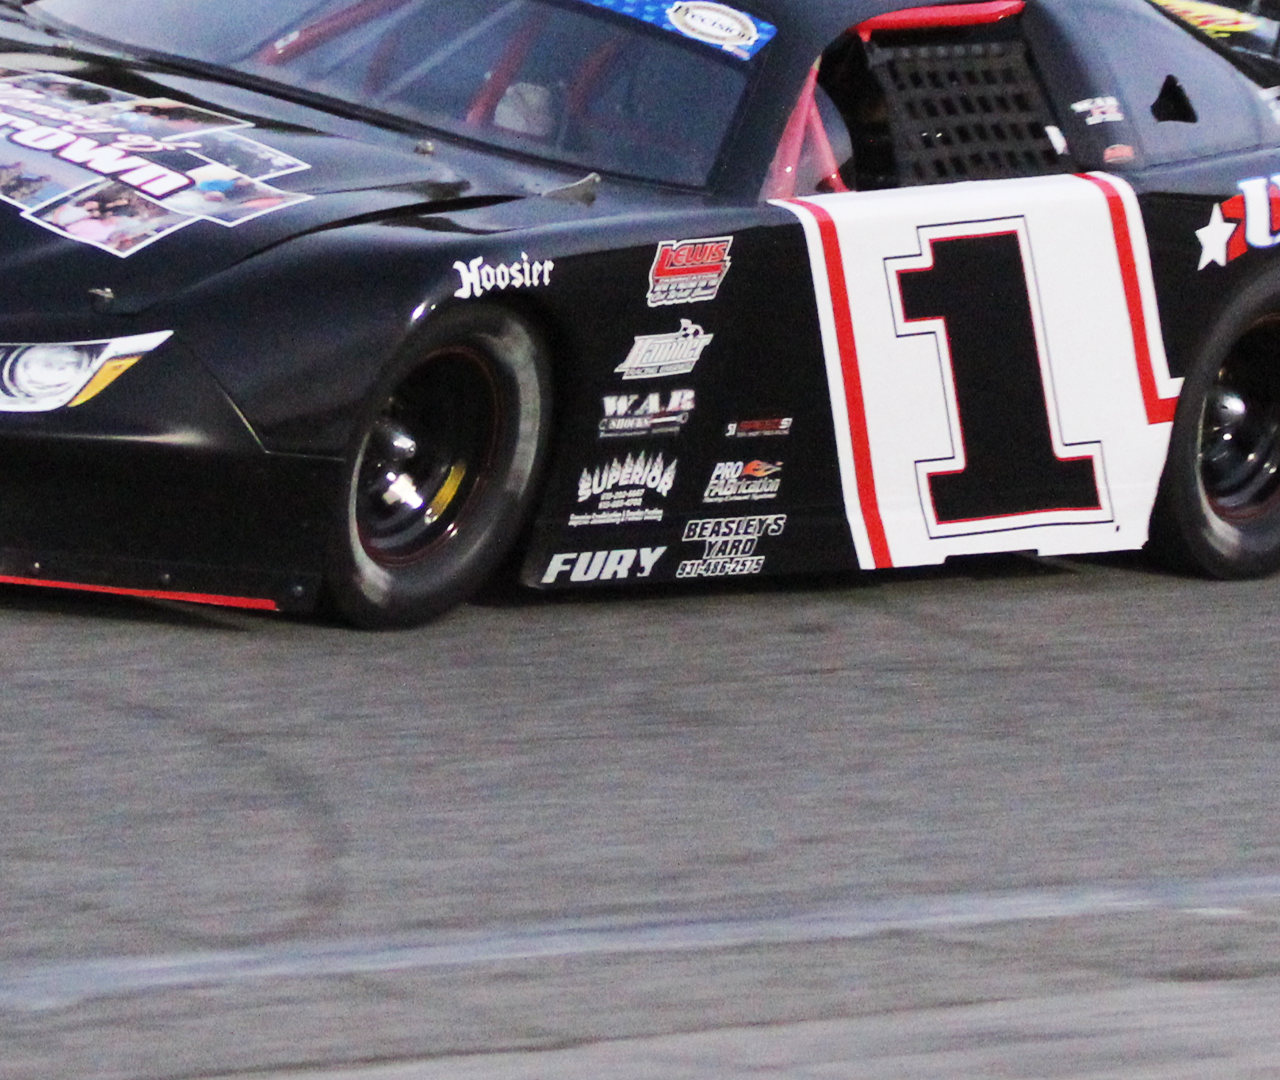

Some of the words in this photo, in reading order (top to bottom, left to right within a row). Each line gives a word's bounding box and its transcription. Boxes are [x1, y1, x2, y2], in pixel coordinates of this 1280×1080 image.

[452, 252, 555, 299] Hoosier
[894, 228, 1104, 528] 1
[577, 450, 678, 503] SUPERIOR
[711, 461, 744, 482] PRO
[682, 514, 788, 541] BEASLEY'S
[540, 546, 668, 584] FURY
[703, 536, 759, 559] YARD
